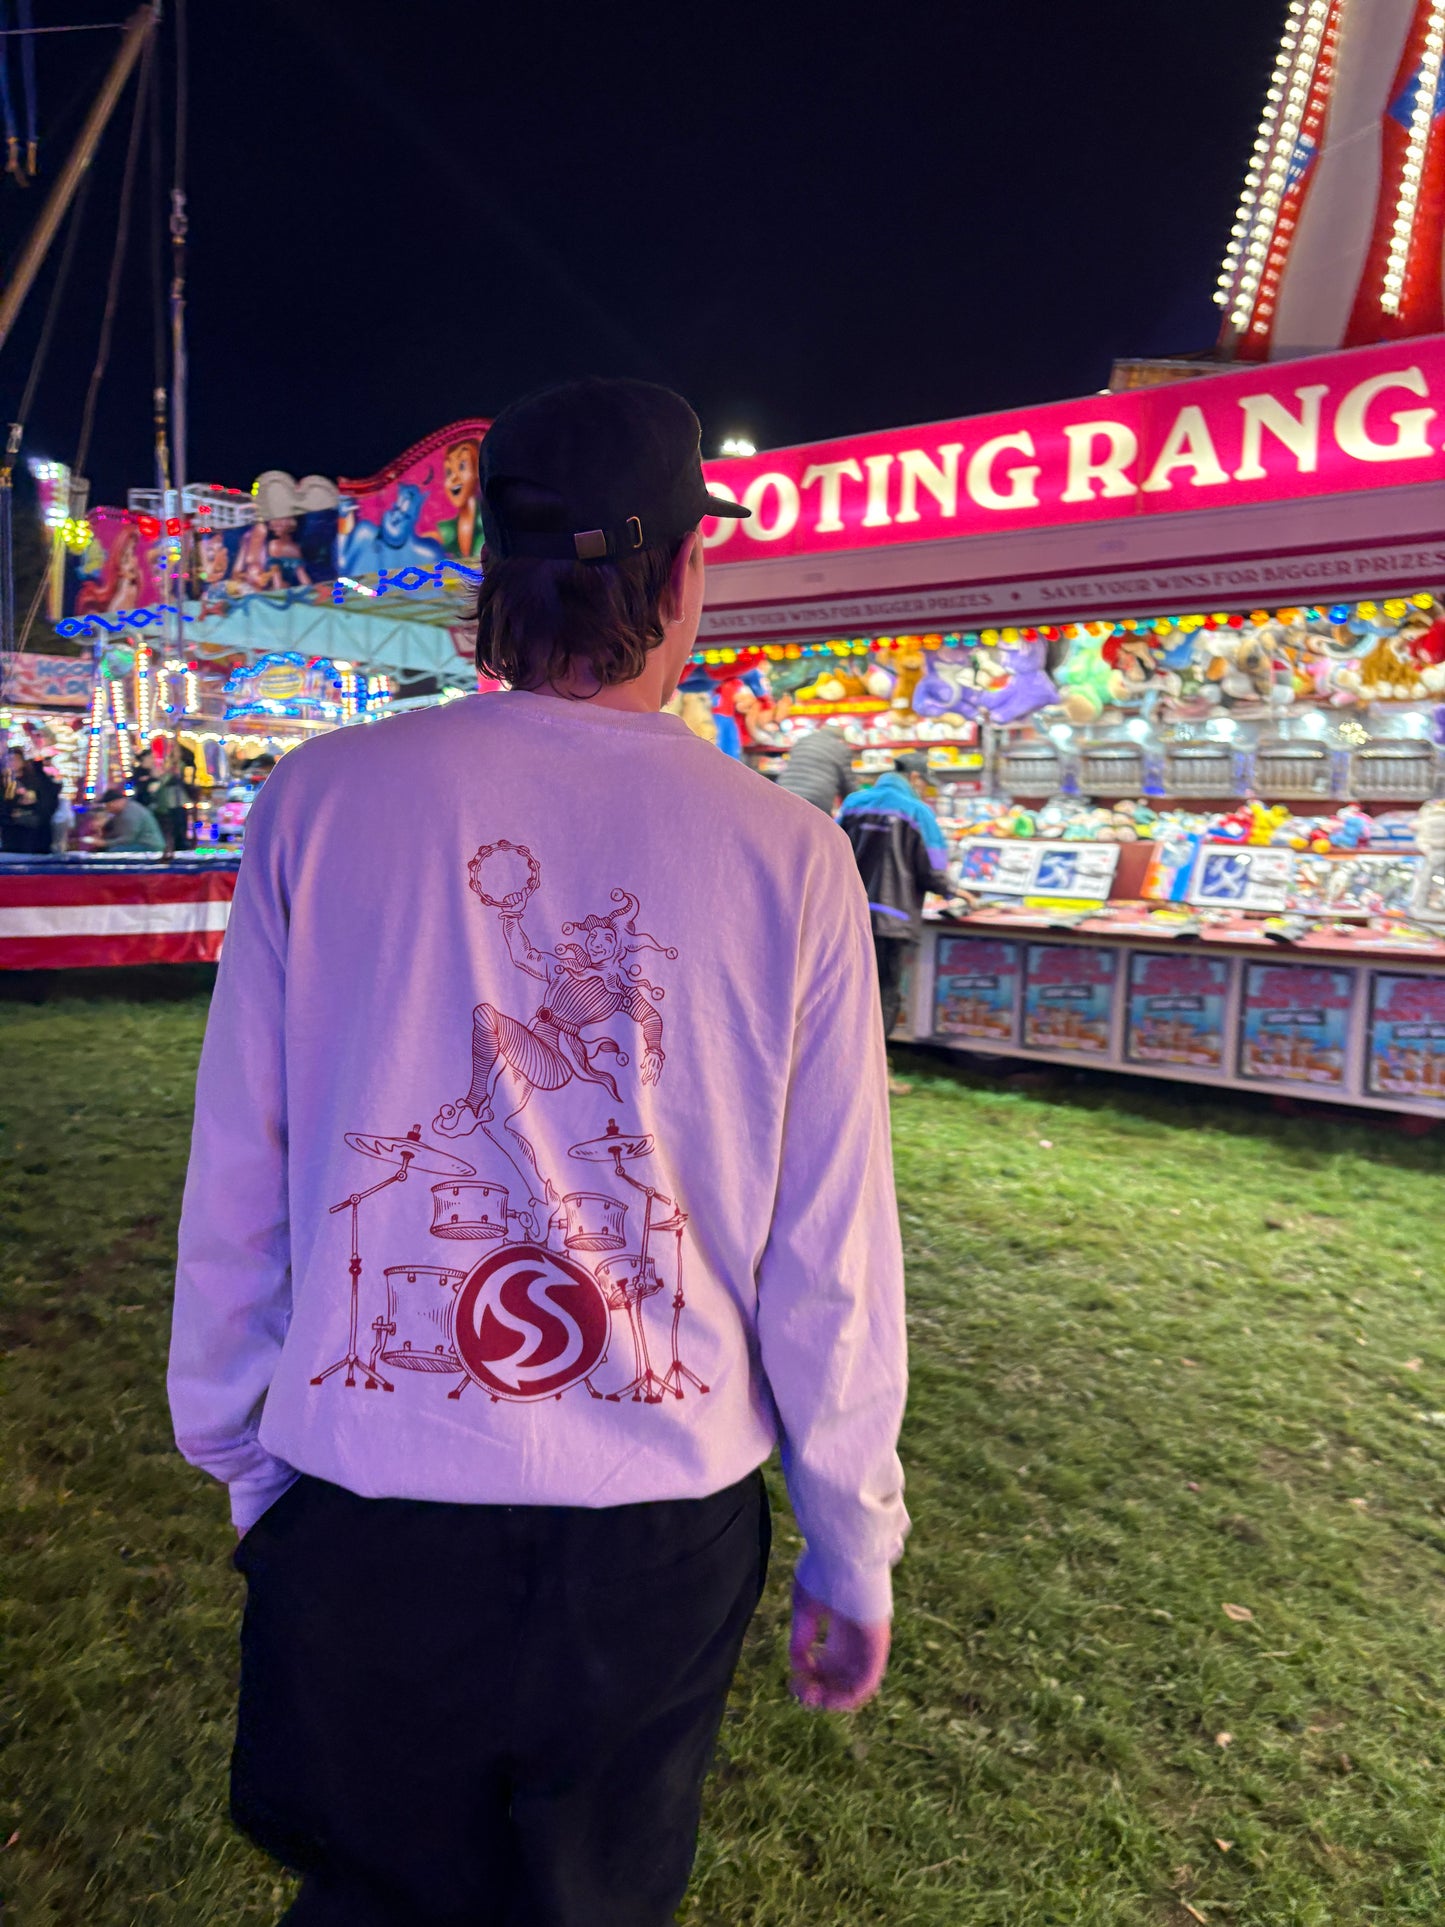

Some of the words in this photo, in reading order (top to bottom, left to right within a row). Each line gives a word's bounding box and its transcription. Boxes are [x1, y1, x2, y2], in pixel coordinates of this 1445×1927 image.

[1060, 366, 1445, 504] RANG
[1040, 582, 1094, 601] SAVE
[1094, 578, 1152, 596] YOUR
[1153, 572, 1211, 590] WINS
[1212, 569, 1259, 586] FOR
[1262, 559, 1352, 582] BIGGER
[1355, 549, 1445, 574] PRIZES
[709, 615, 747, 629] SAVE
[791, 607, 830, 623] WINS
[863, 599, 925, 617] BIGGER
[926, 592, 993, 611] PRIZES
